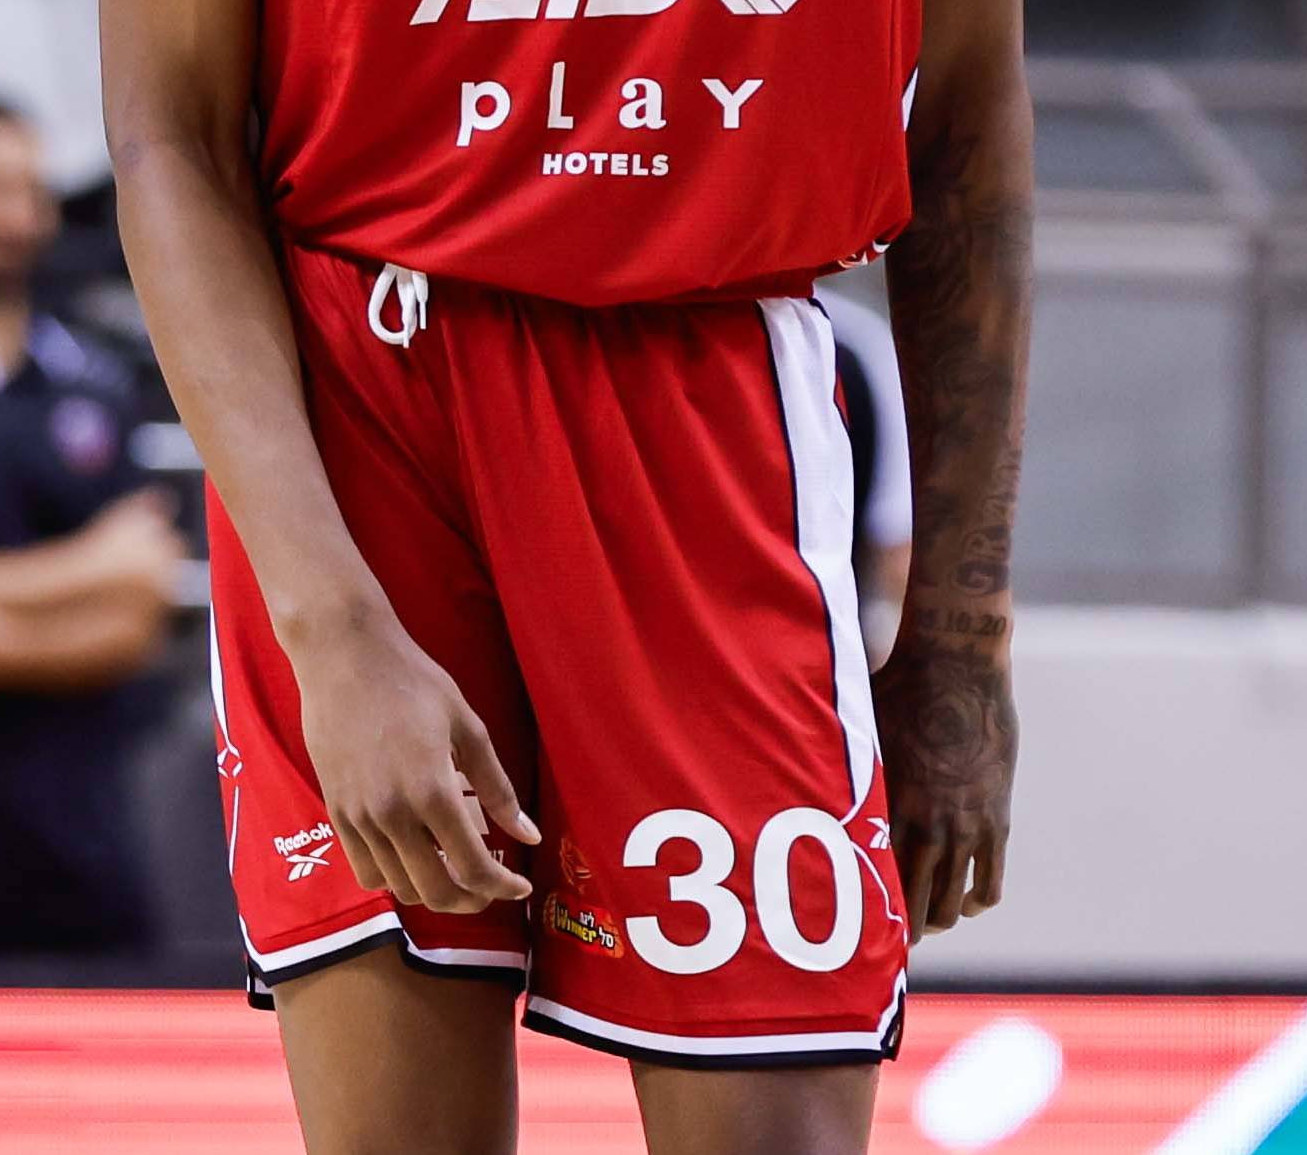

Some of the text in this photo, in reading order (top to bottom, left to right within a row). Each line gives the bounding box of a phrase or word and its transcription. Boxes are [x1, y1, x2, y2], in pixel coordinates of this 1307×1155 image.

[542, 152, 669, 176] HOTELS
[274, 822, 334, 856] Reebok
[622, 807, 863, 975] 30
